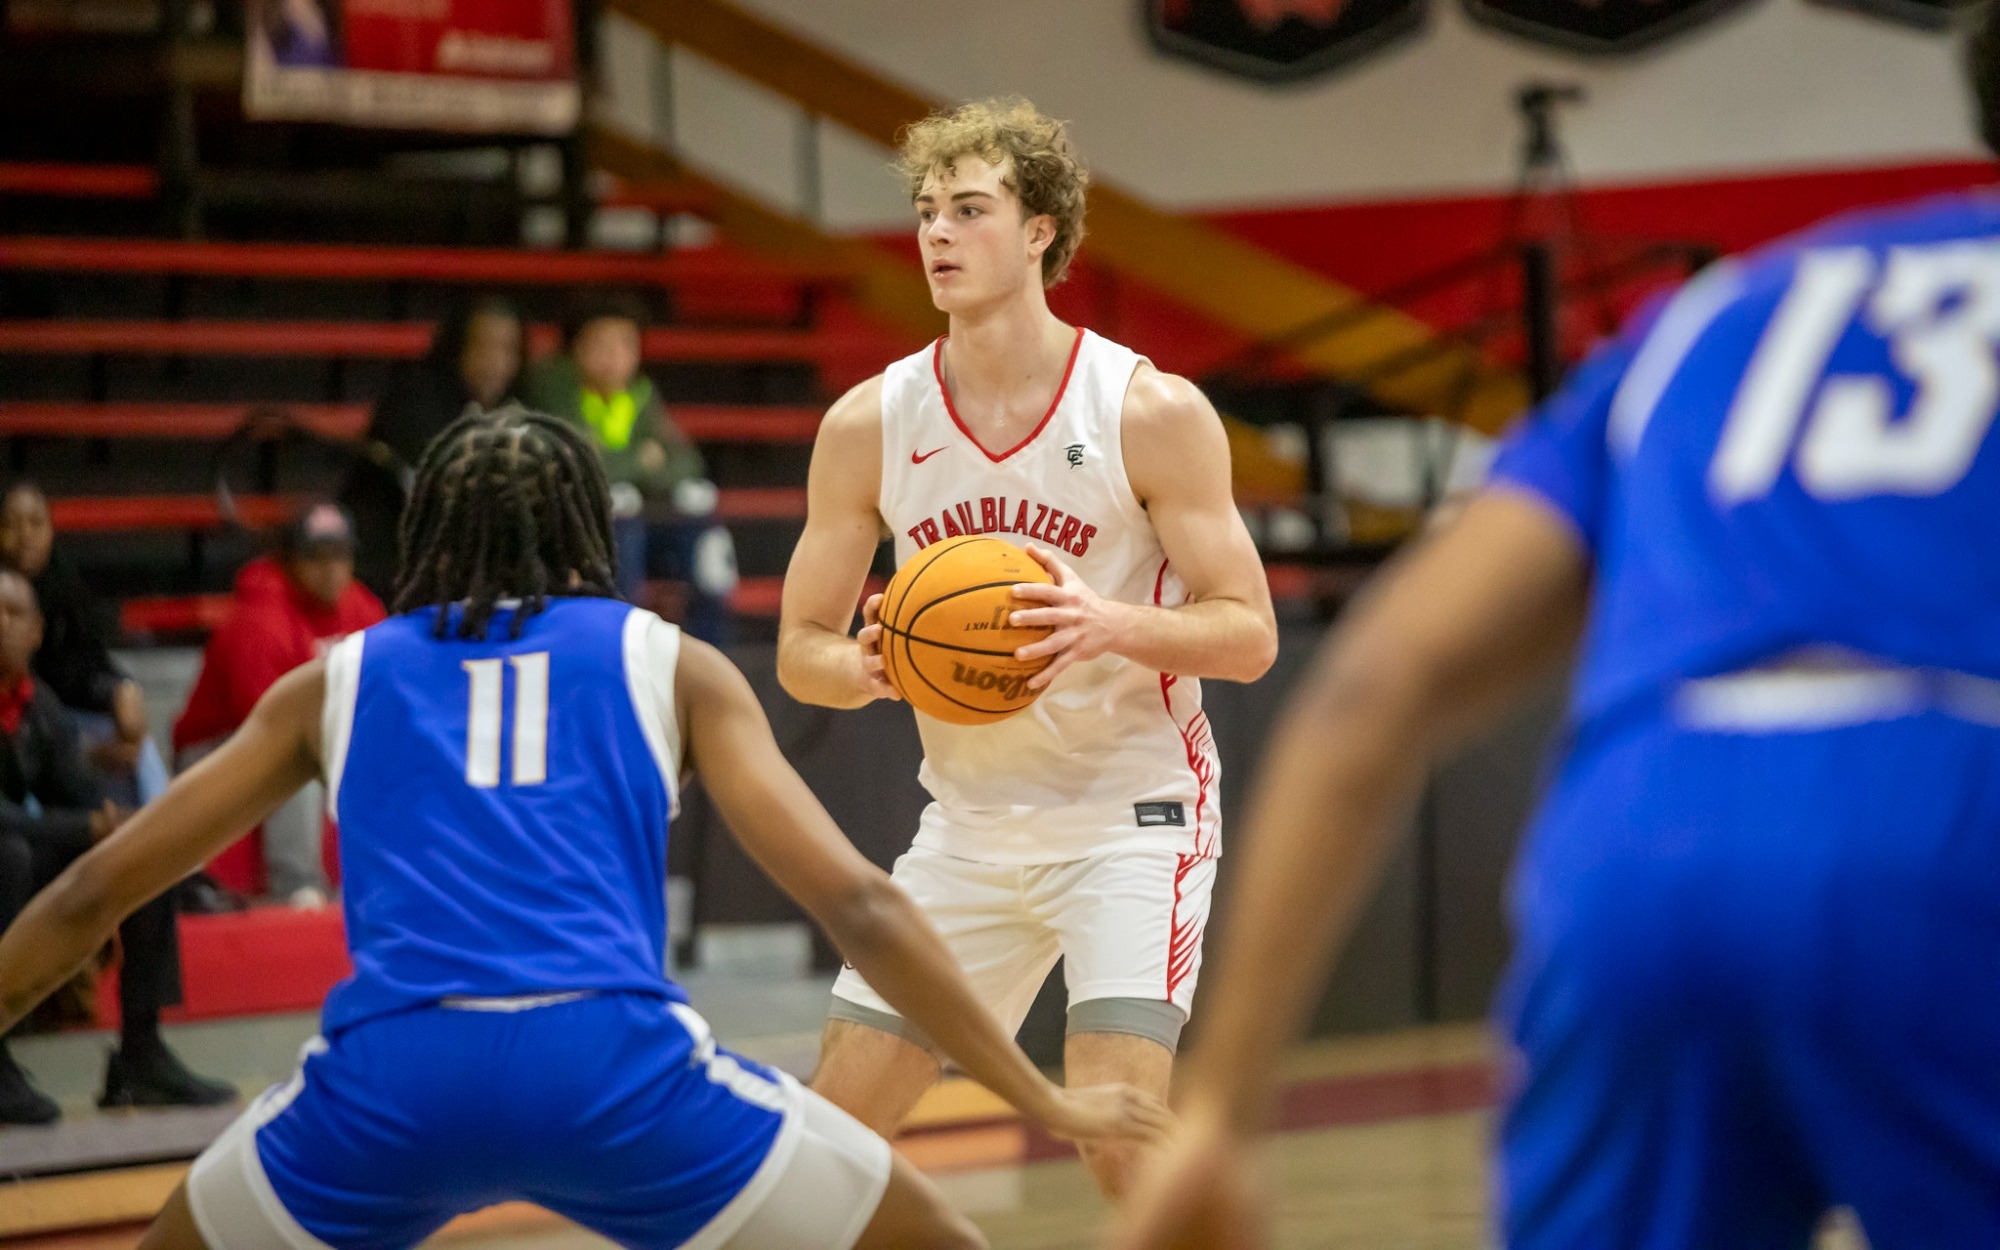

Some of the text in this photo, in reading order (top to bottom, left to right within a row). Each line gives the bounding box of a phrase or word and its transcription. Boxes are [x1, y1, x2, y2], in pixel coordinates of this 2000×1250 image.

[1706, 240, 2000, 503] 13
[908, 497, 1098, 557] TRAILBLAZERS
[461, 651, 550, 788] 11
